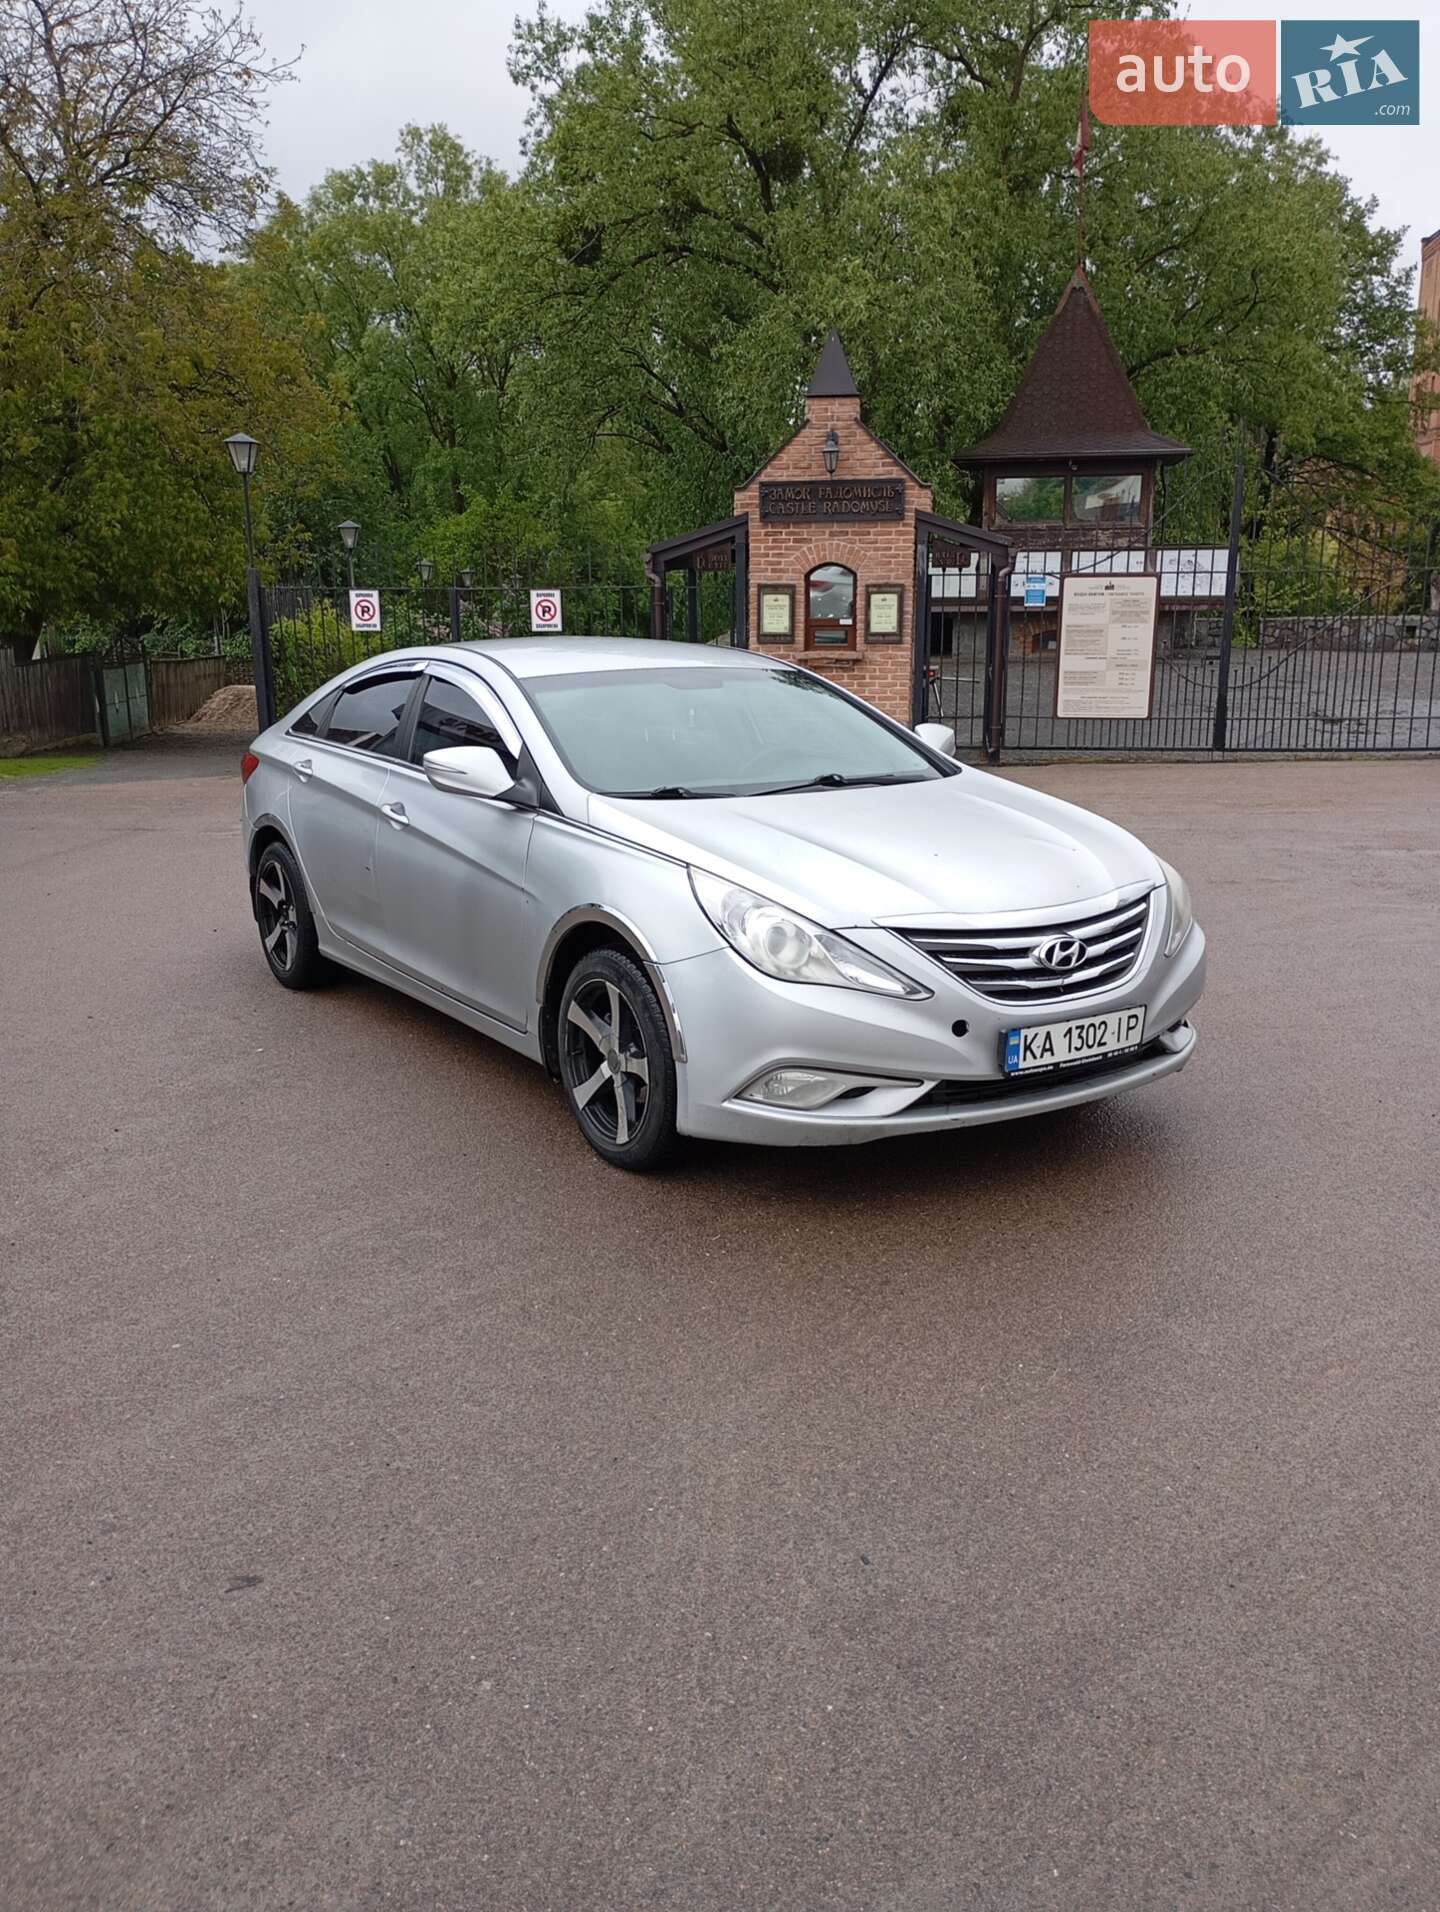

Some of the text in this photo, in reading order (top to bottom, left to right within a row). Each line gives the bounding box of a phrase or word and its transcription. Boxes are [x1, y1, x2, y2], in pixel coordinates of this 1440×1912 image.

[768, 500, 893, 514] CASTLE RADOMYSL
[1022, 1014, 1139, 1062] KA 1302 IP
[1008, 1054, 1018, 1064] UA
